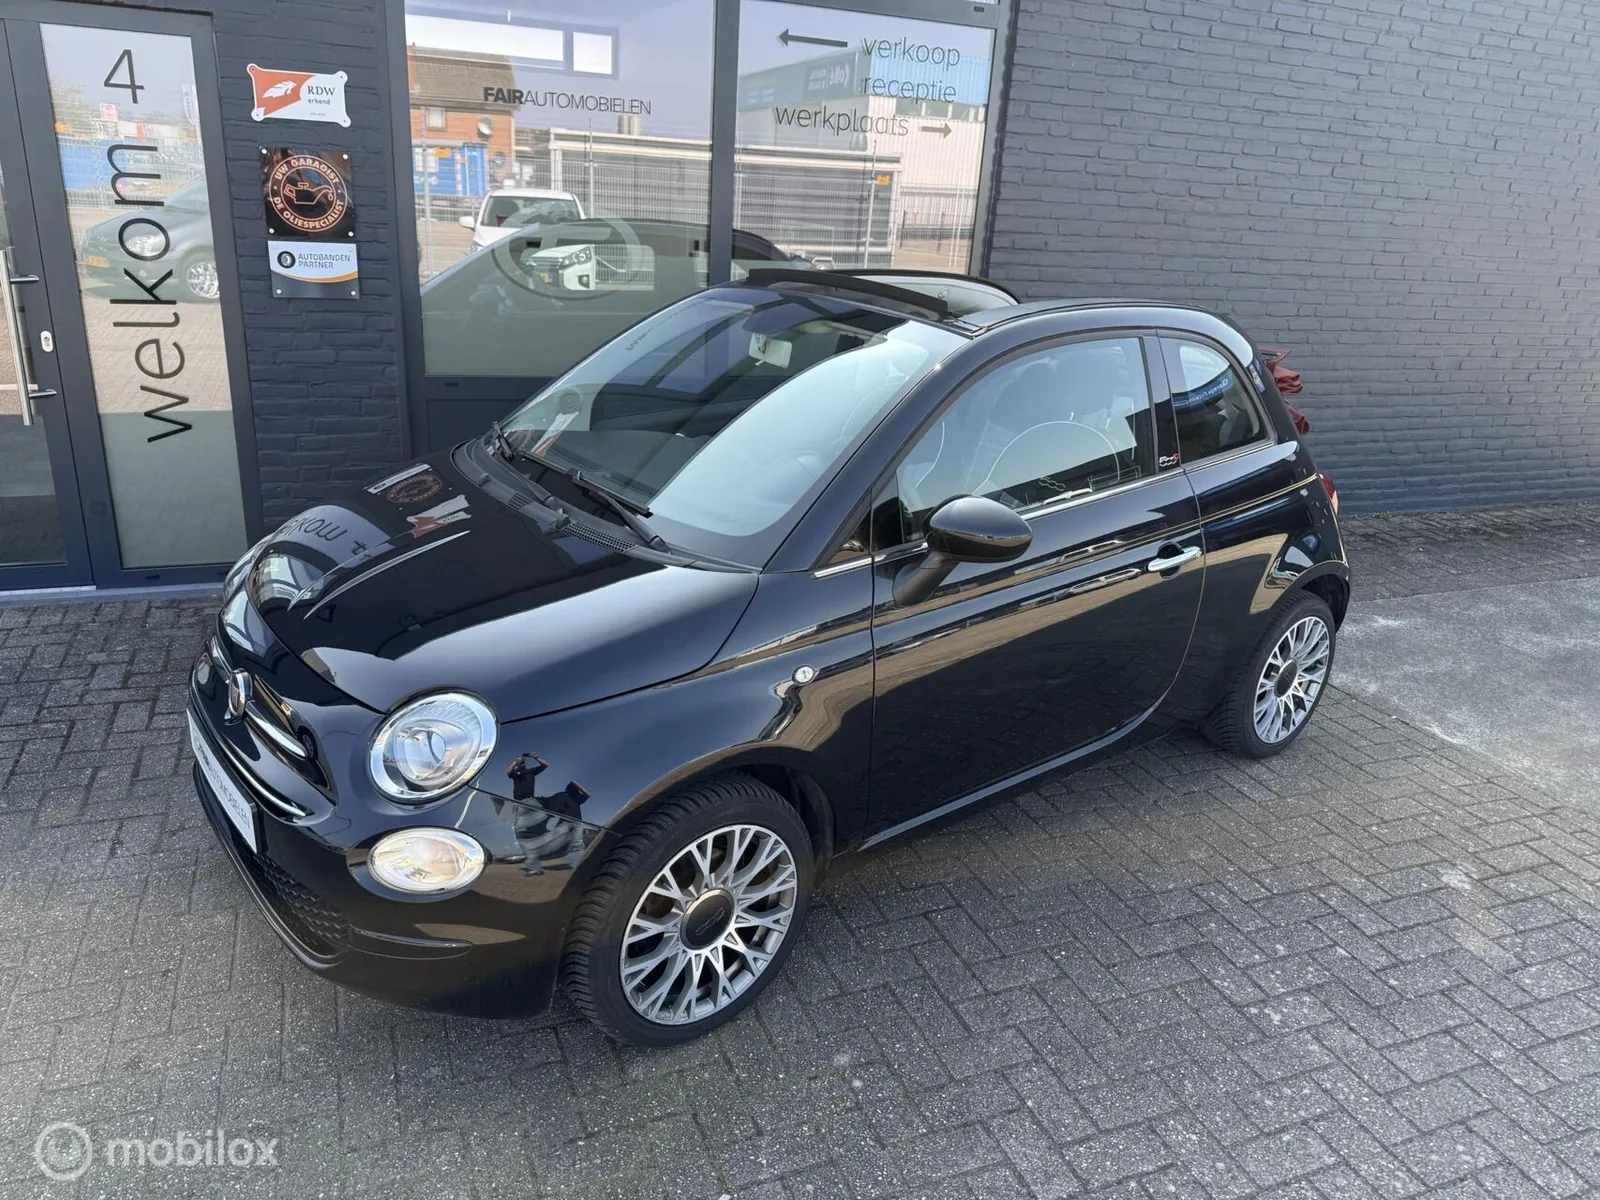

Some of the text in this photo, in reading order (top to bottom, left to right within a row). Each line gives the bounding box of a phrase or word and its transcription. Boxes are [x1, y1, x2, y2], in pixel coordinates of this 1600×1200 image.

[862, 36, 961, 68] verkoop
[103, 49, 145, 105] 4
[307, 85, 336, 96] RDW
[862, 76, 957, 105] receptie
[307, 97, 331, 105] erkend
[483, 86, 652, 115] FAIRAUTOMOBIELEN
[775, 105, 909, 136] werkplaats
[274, 163, 289, 181] UW
[273, 196, 345, 230] DE OLIESPECIALIST
[297, 253, 351, 261] AUTOBANDEN
[298, 260, 335, 269] PARTNER
[106, 143, 192, 443] welkom
